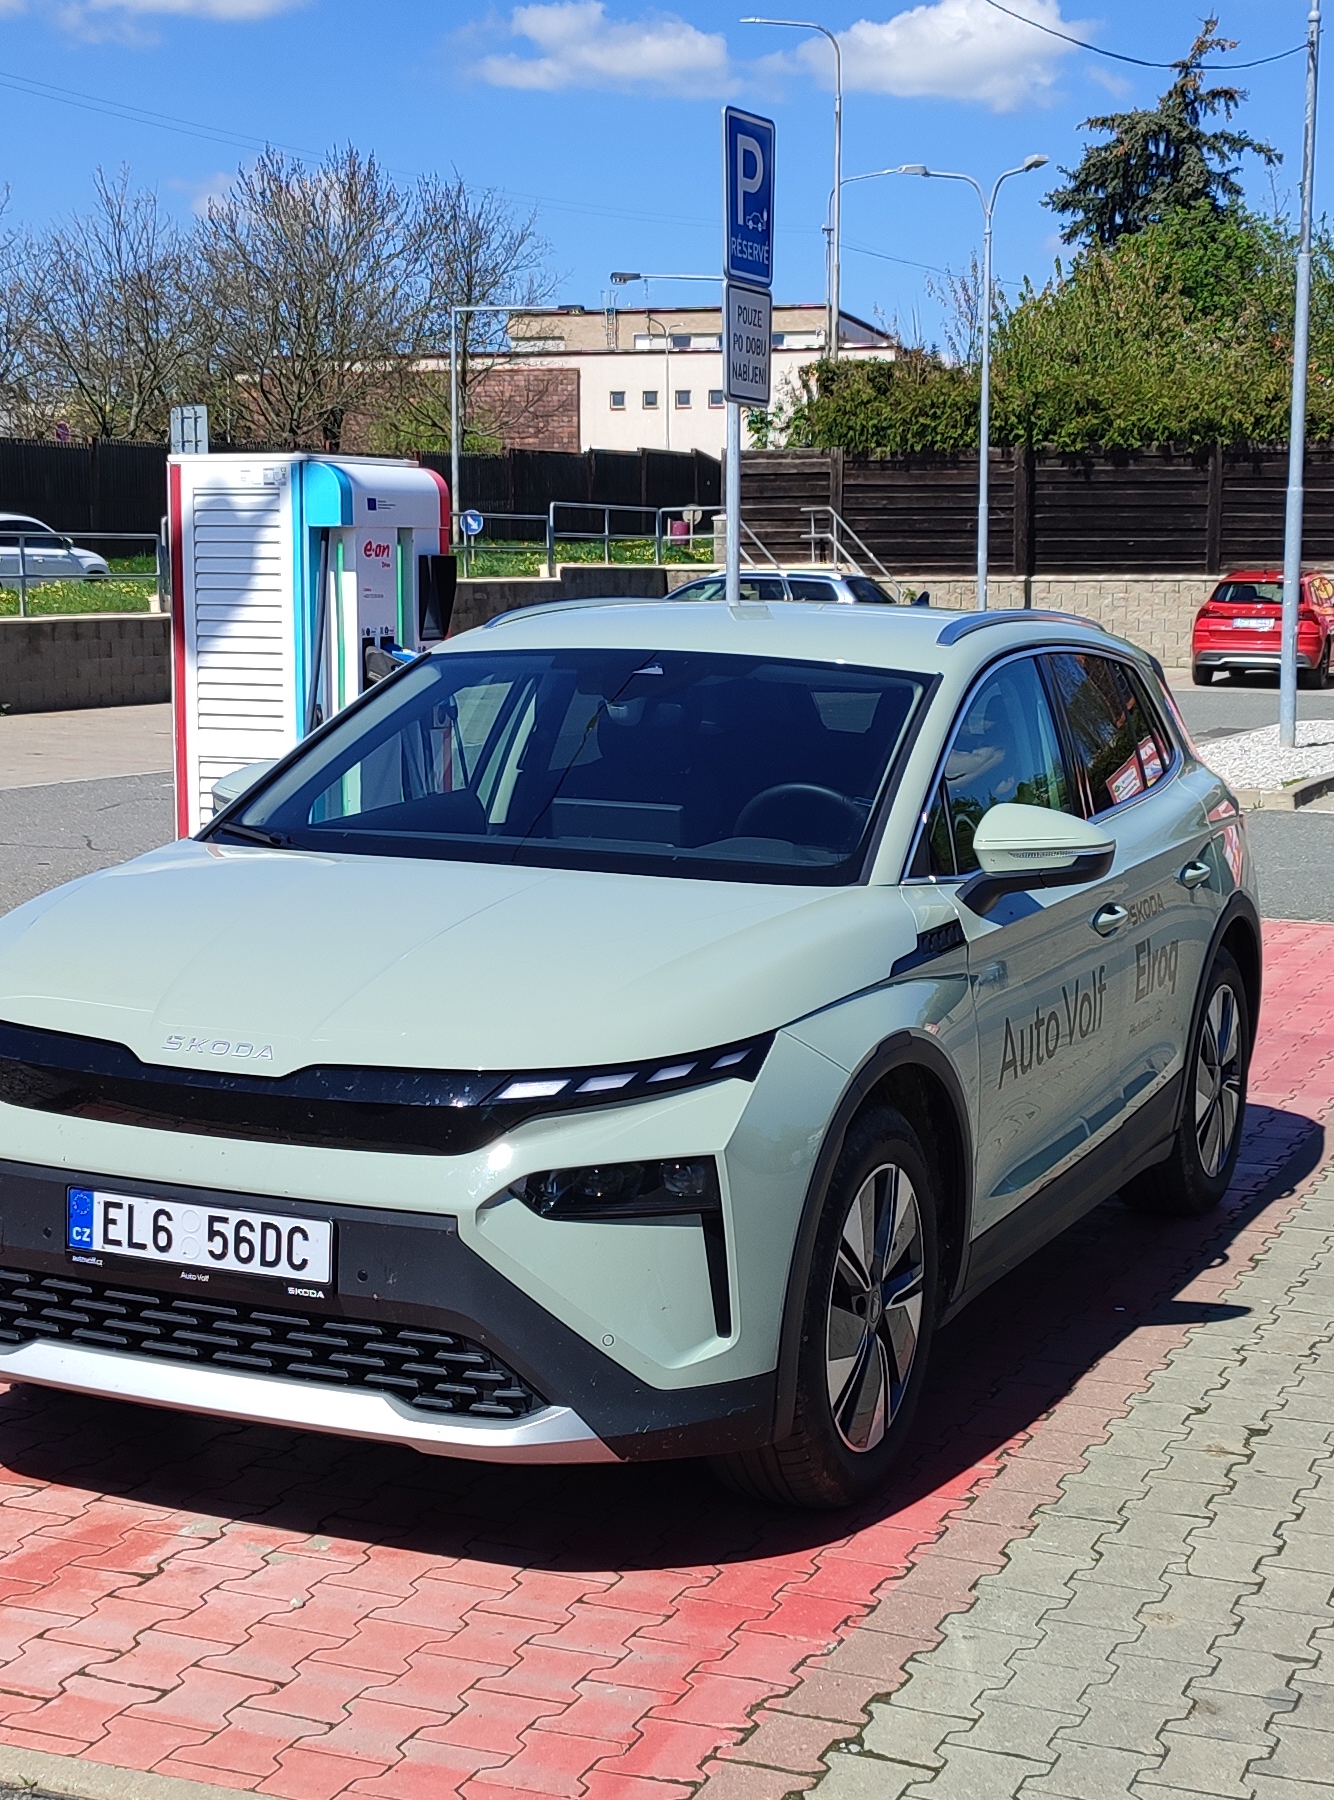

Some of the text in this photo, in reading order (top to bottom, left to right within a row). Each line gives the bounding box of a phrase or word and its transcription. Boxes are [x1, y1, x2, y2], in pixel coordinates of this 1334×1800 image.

[736, 133, 763, 226] P
[731, 234, 769, 264] RÉSERVÉ
[737, 304, 762, 328] POUZE
[733, 333, 766, 357] PO DOBU
[732, 359, 766, 385] NABÍJENÍ
[1135, 938, 1179, 1003] Elroq
[998, 965, 1107, 1090] Auto Volf
[72, 1226, 91, 1242] CZ
[103, 1200, 309, 1271] EL6 56DC
